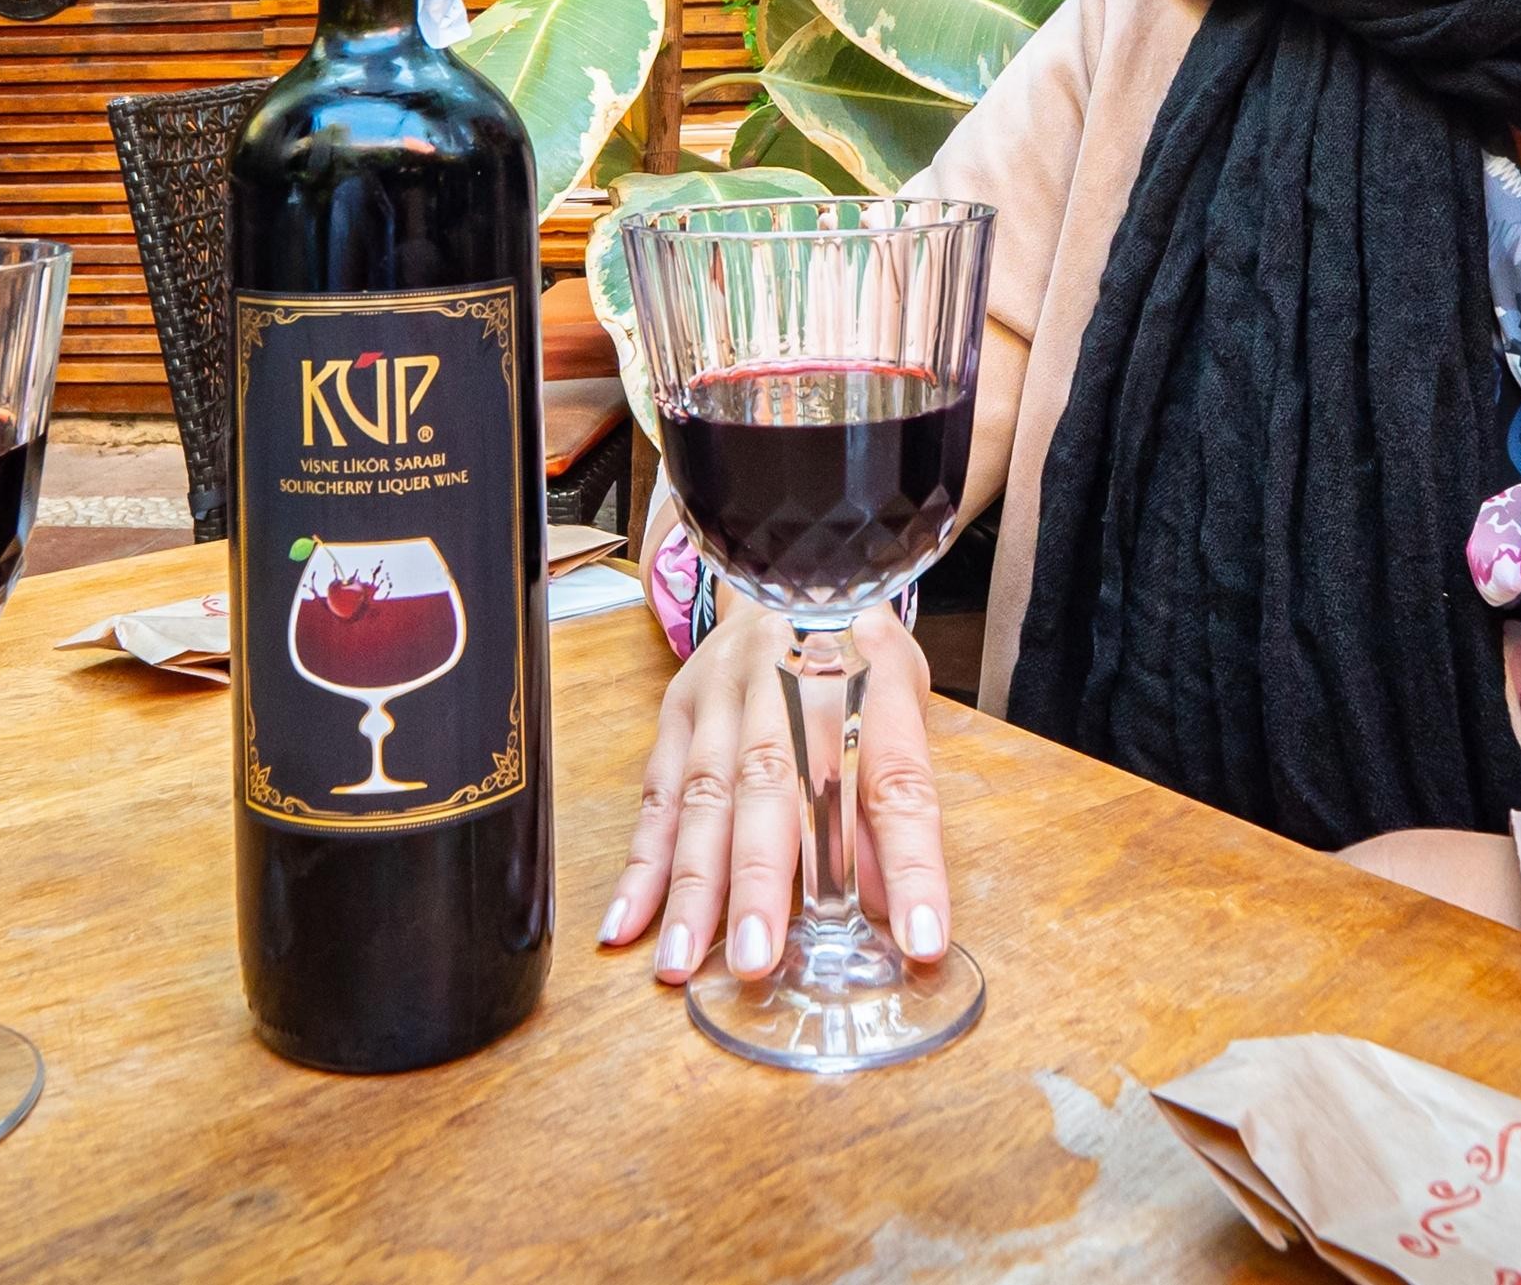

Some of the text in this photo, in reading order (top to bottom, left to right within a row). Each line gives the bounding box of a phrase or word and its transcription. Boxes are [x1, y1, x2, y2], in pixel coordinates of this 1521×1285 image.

[279, 470, 469, 495] SOURCHERRY LIQUER WINE
